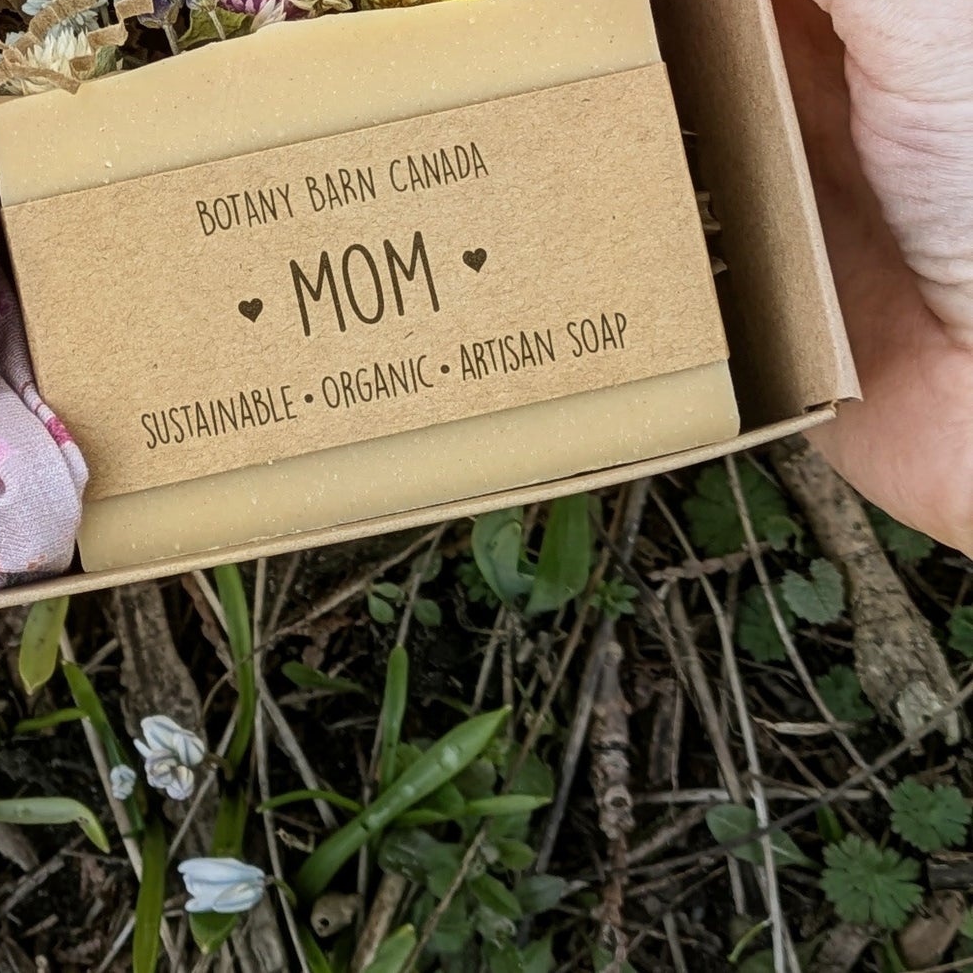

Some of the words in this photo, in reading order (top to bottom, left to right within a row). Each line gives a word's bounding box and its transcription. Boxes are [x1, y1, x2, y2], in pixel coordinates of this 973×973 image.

[196, 184, 295, 237] BOTANY
[305, 166, 376, 211] BARN
[389, 141, 489, 193] CANADA
[289, 230, 441, 337] MOM
[141, 385, 298, 450] SUSTAINABLE
[322, 354, 434, 410] ORGANIC
[459, 327, 556, 382] ARTISAN
[566, 312, 629, 358] SOAP
